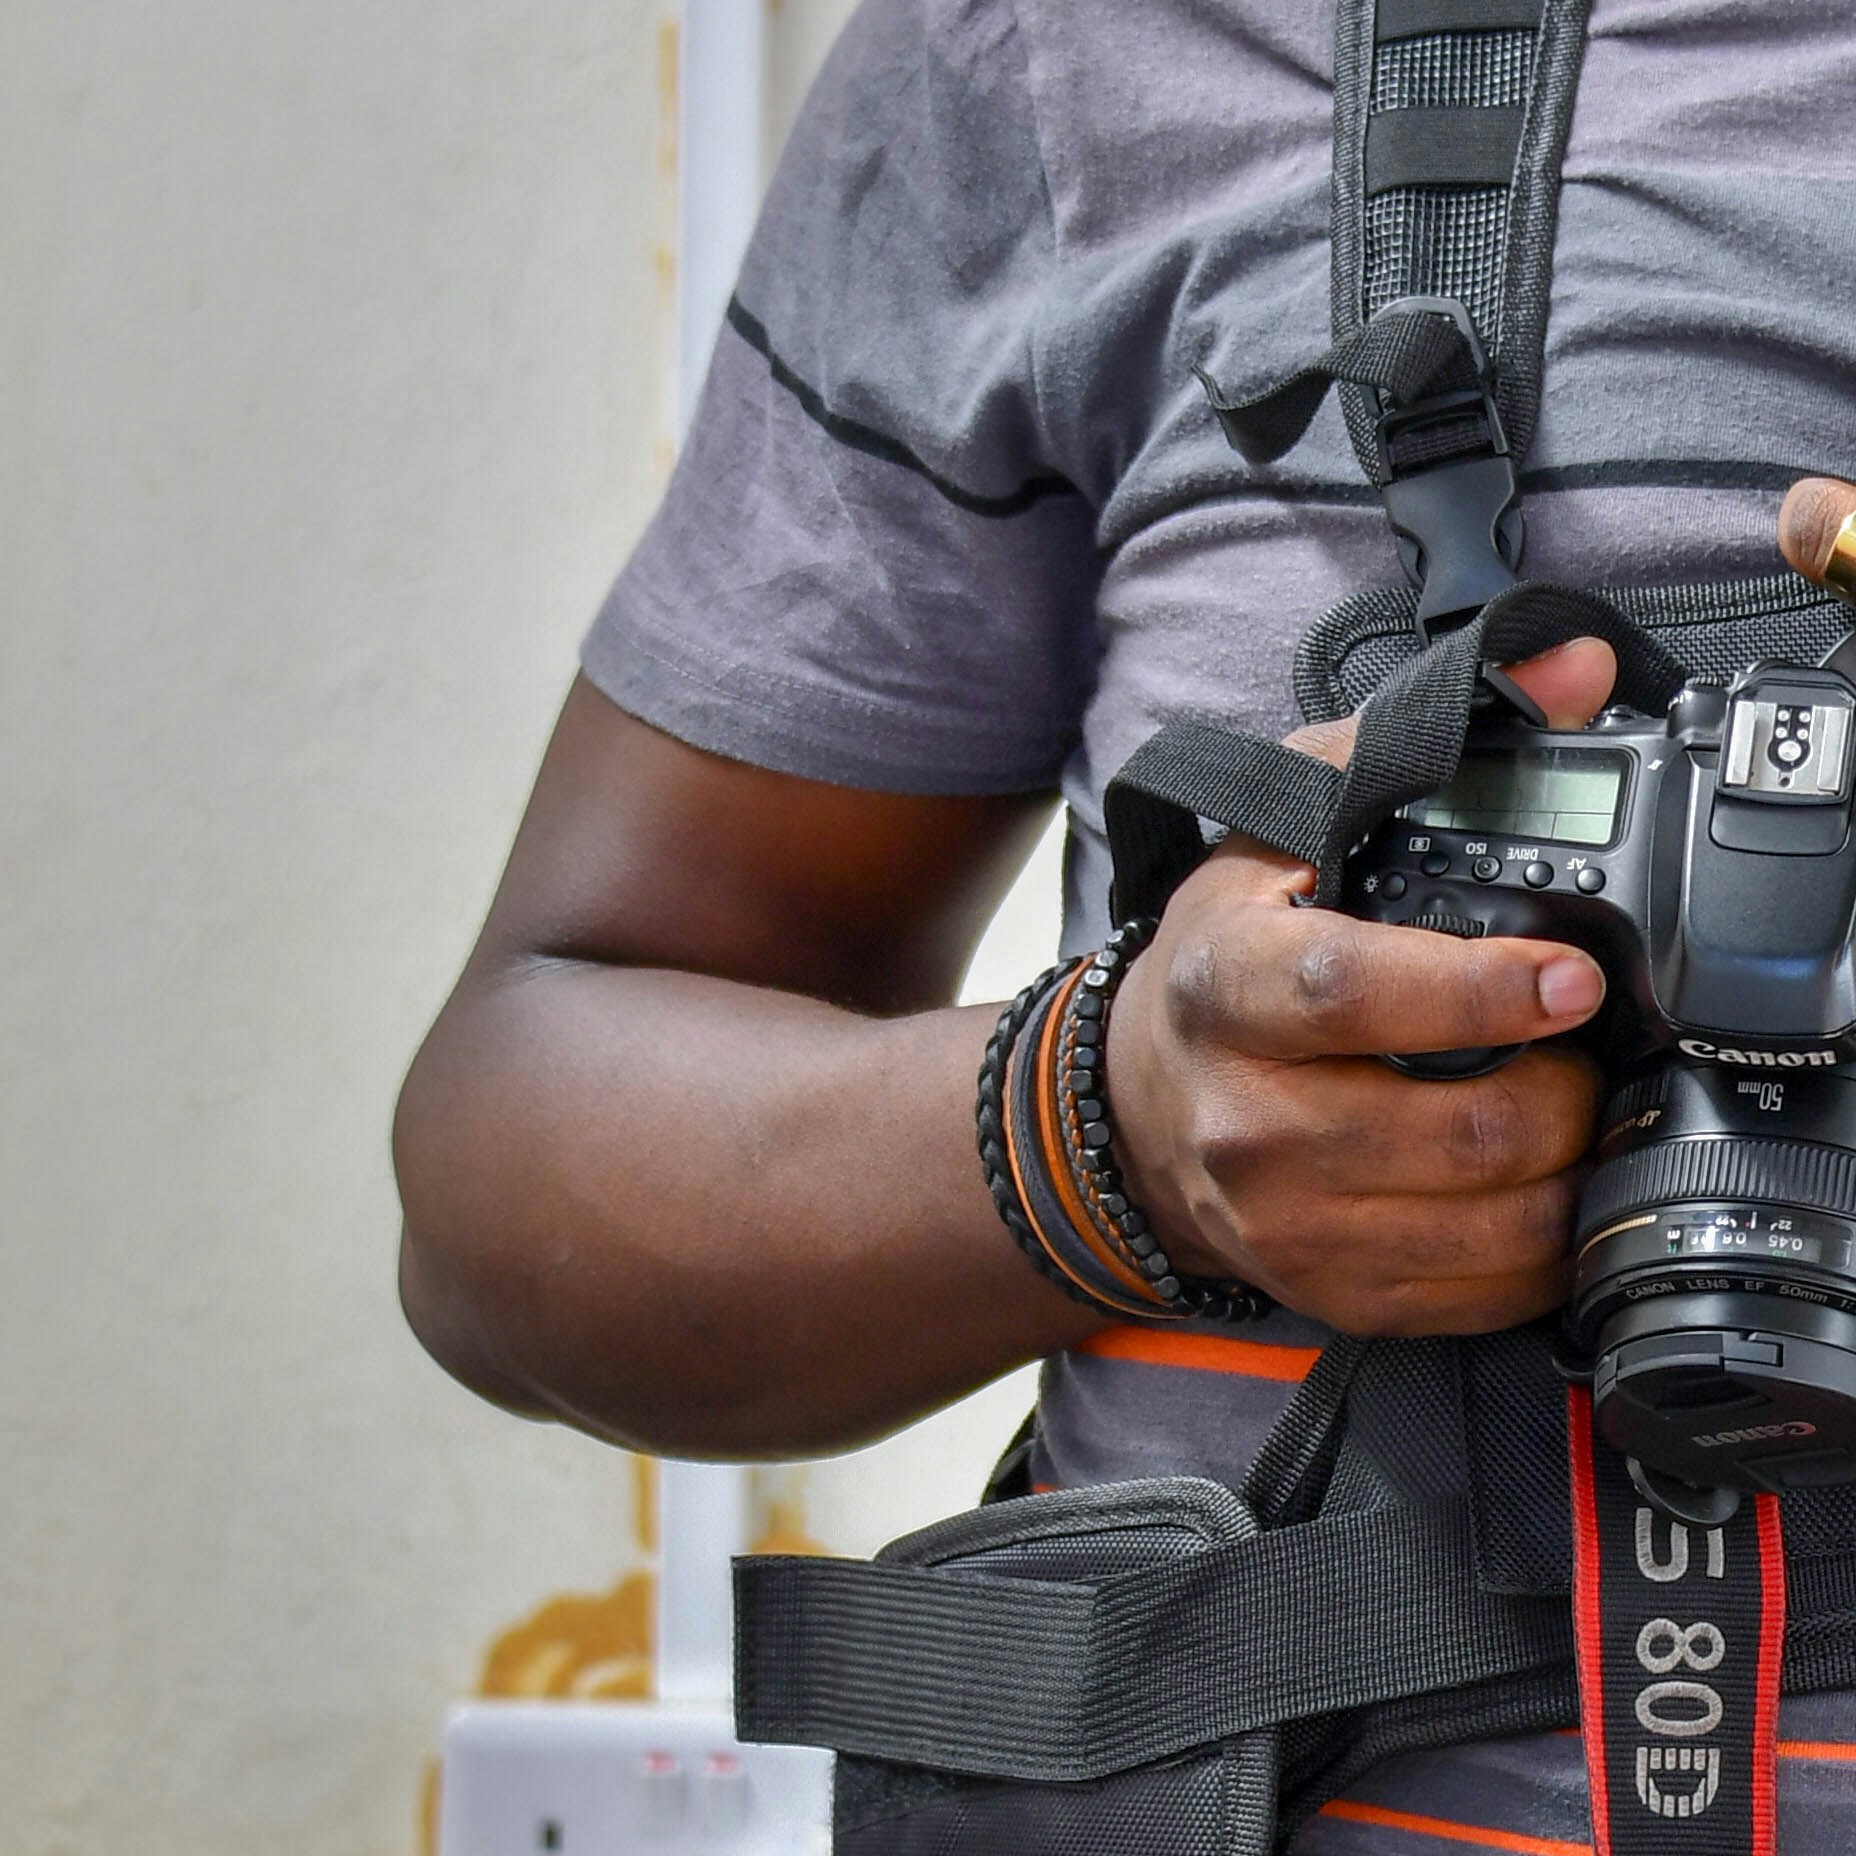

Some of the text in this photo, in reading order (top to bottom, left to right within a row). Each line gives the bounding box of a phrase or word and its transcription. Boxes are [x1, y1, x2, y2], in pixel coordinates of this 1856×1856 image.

[1465, 842, 1487, 855] ISO
[1506, 847, 1539, 861] DRIVE
[1565, 857, 1587, 871] AF
[1677, 1038, 1838, 1068] Canon
[1737, 1081, 1784, 1112] 50mm
[1768, 1234, 1803, 1252] 0.45
[1625, 1280, 1676, 1301] CANON
[1686, 1278, 1730, 1291] LENS
[1744, 1280, 1766, 1293] EF
[1778, 1284, 1829, 1305] 50mm
[1690, 1420, 1817, 1448] Canon
[1634, 1617, 1726, 1819] 80D
